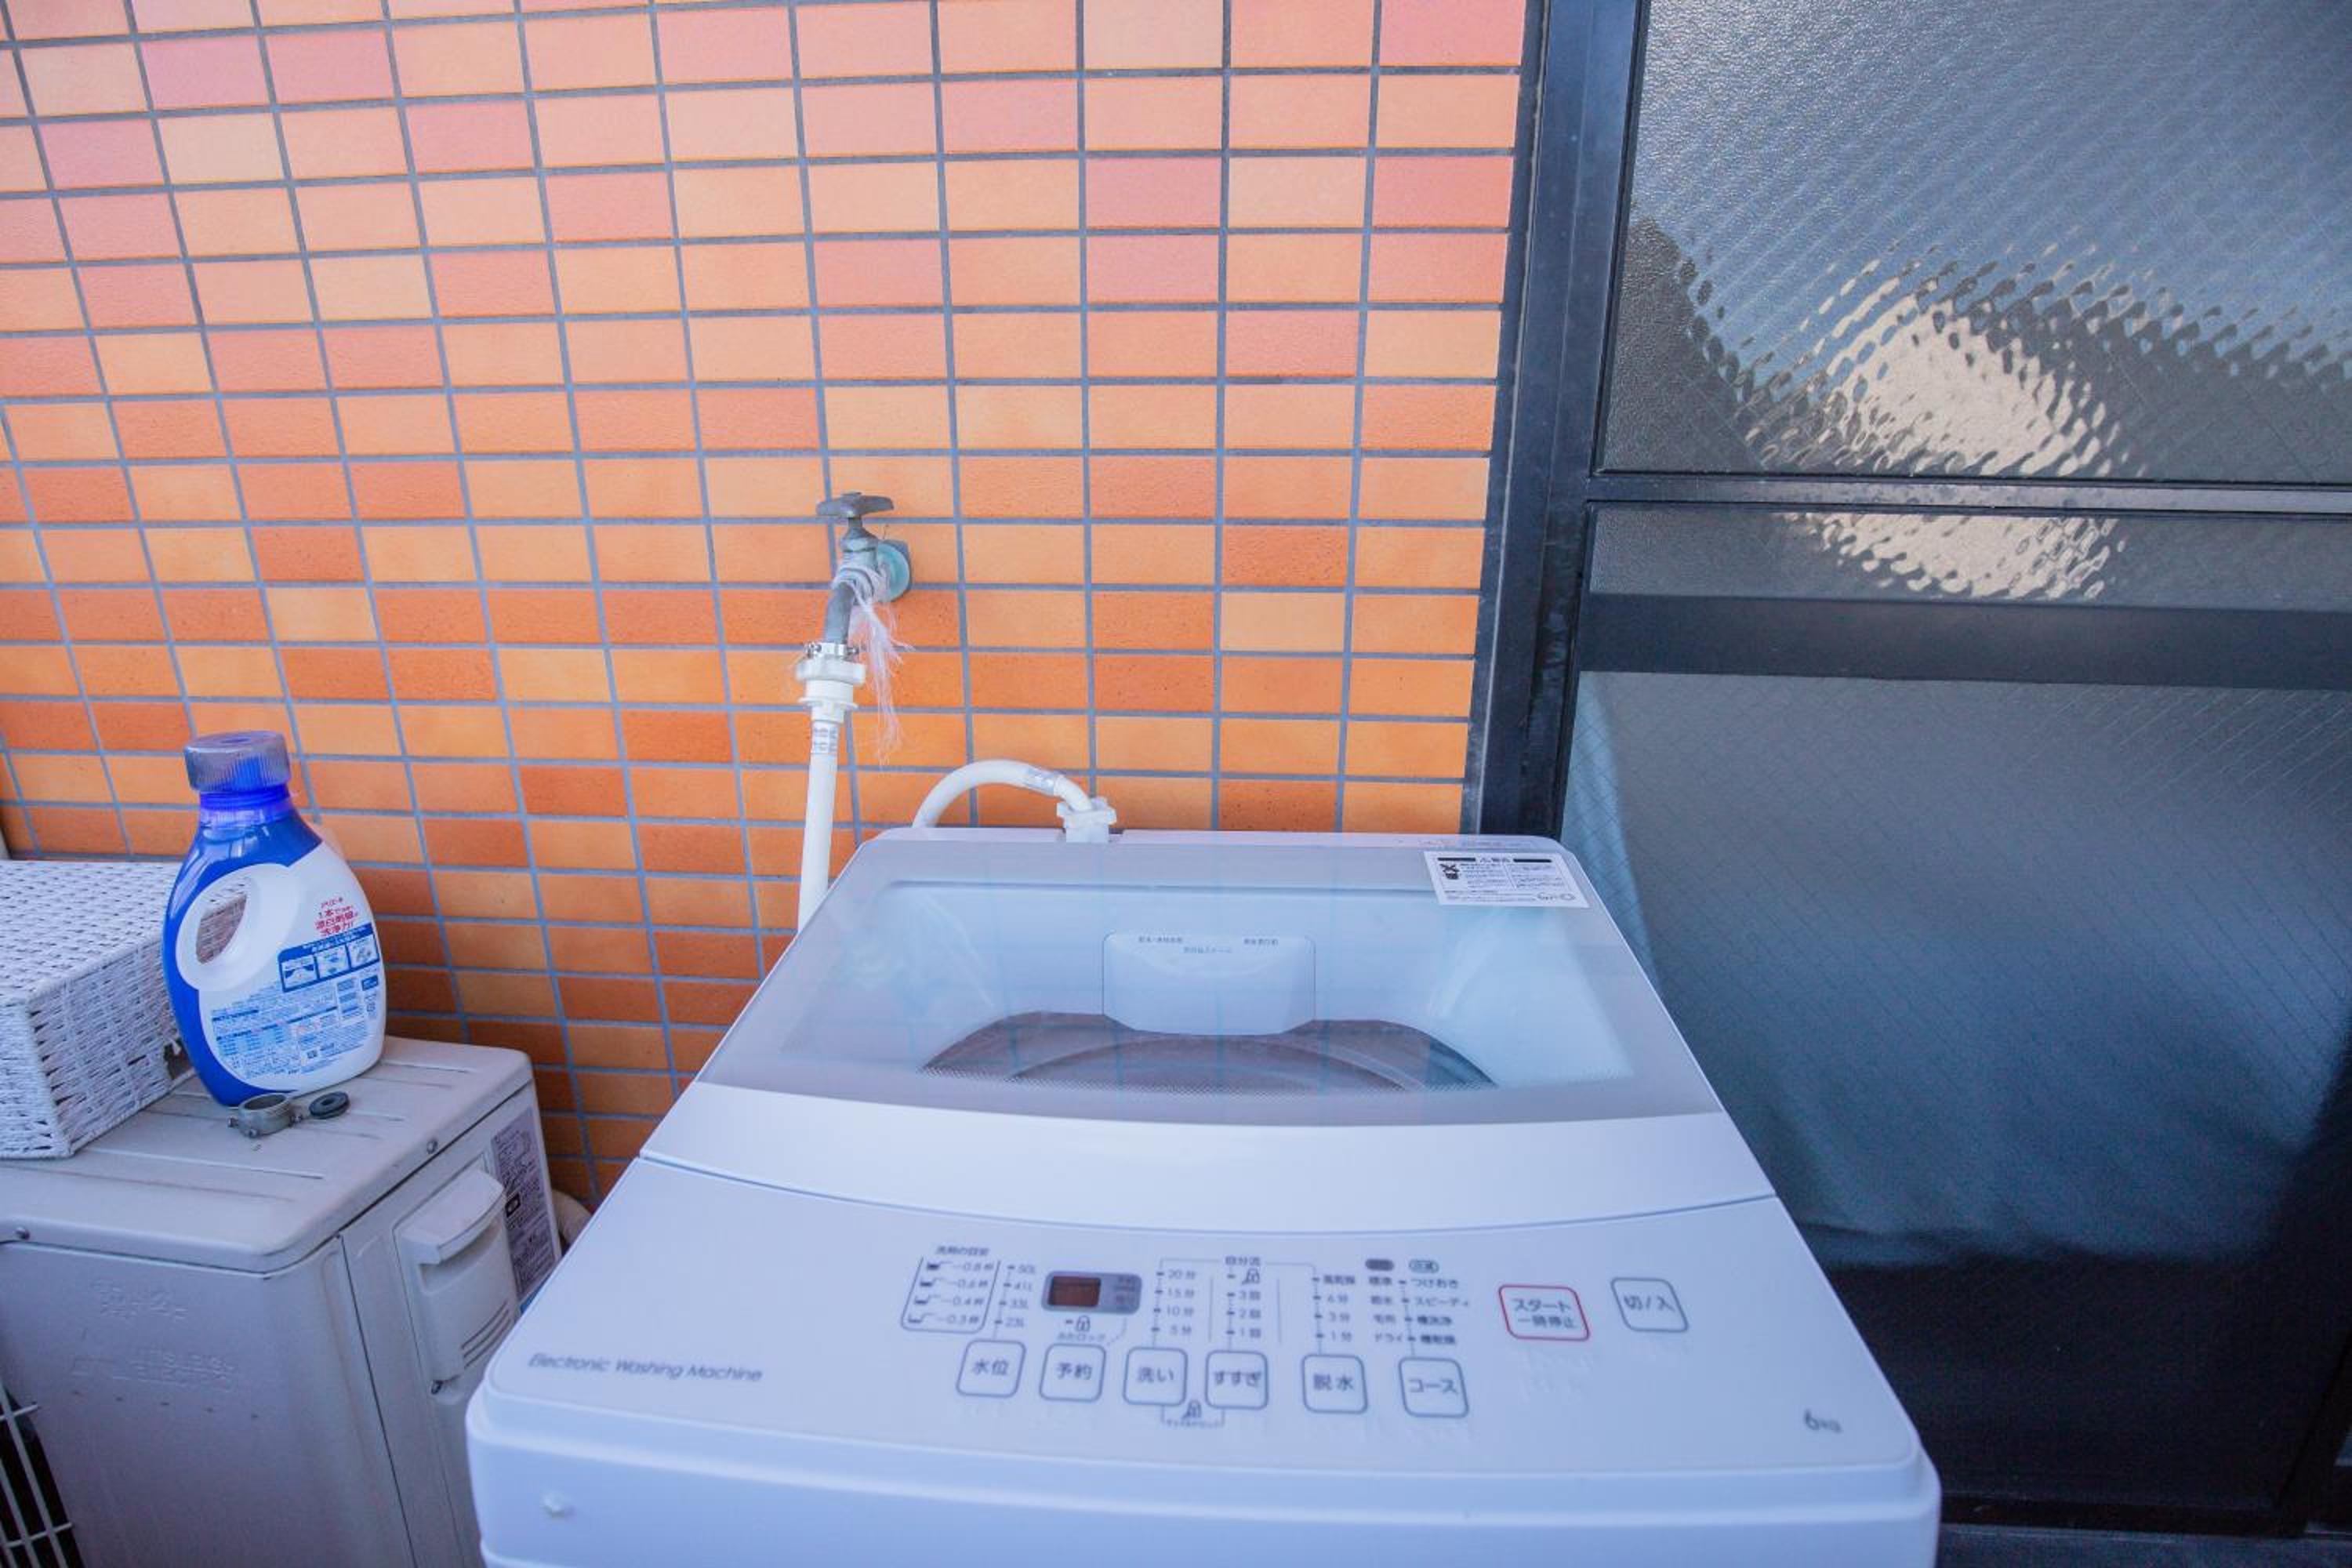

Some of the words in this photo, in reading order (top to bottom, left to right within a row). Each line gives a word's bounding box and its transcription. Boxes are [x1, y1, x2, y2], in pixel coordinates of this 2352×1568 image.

[1512, 1298, 1572, 1312] スタート
[615, 1359, 684, 1380] Washing
[686, 1363, 763, 1382] Machine
[973, 1359, 1009, 1376] 水位
[1056, 1362, 1093, 1380] 予約
[1138, 1367, 1174, 1384] 洗い
[1214, 1370, 1262, 1388] すすぎ
[1312, 1374, 1355, 1392] 脱水
[1410, 1377, 1459, 1395] コース
